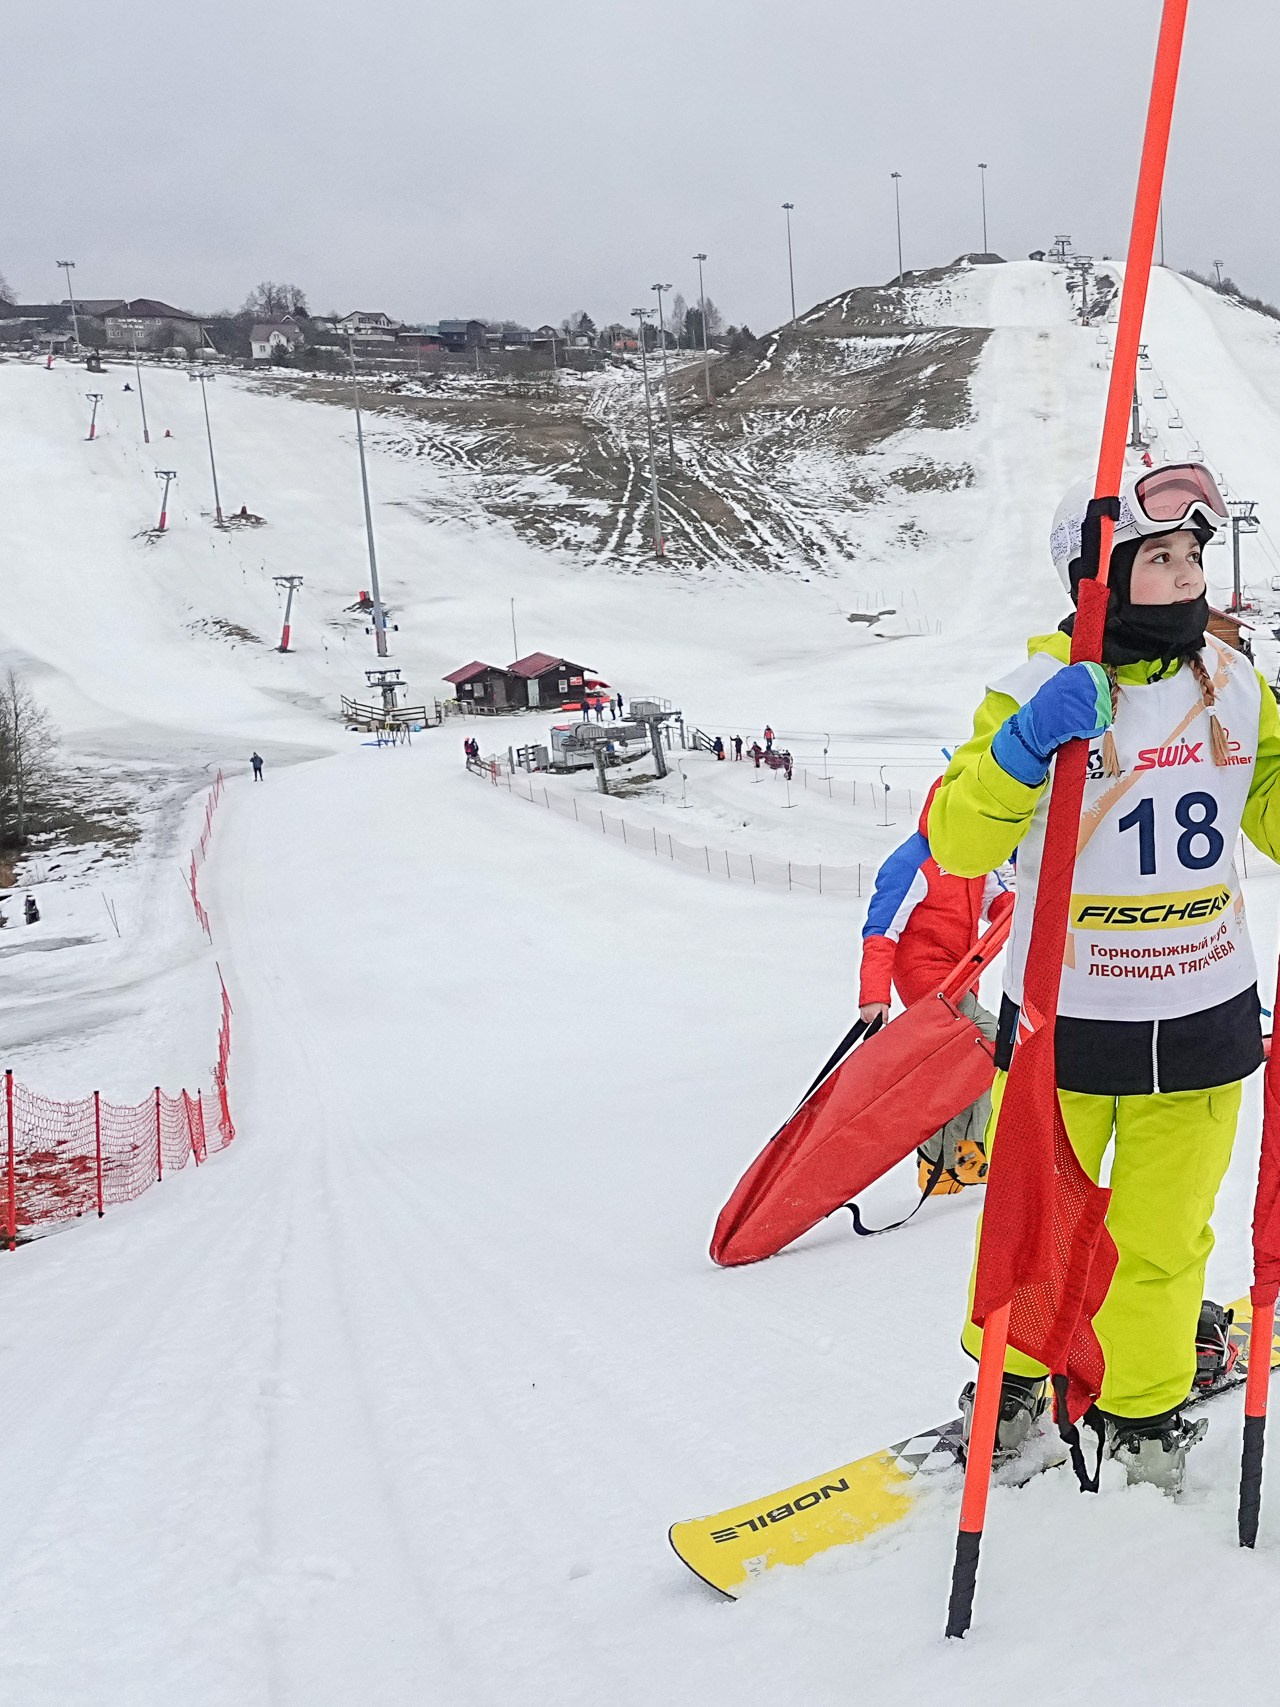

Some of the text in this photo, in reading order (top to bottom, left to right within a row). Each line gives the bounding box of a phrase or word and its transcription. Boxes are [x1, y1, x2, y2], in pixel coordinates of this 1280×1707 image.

[1118, 791, 1225, 875] 18
[1077, 896, 1222, 924] FISCHER
[1088, 940, 1236, 981] ЛЕОНИДА ТЯГАЧЁВА
[1090, 937, 1208, 960] Горнолыжный
[710, 1478, 850, 1543] NOBILE
